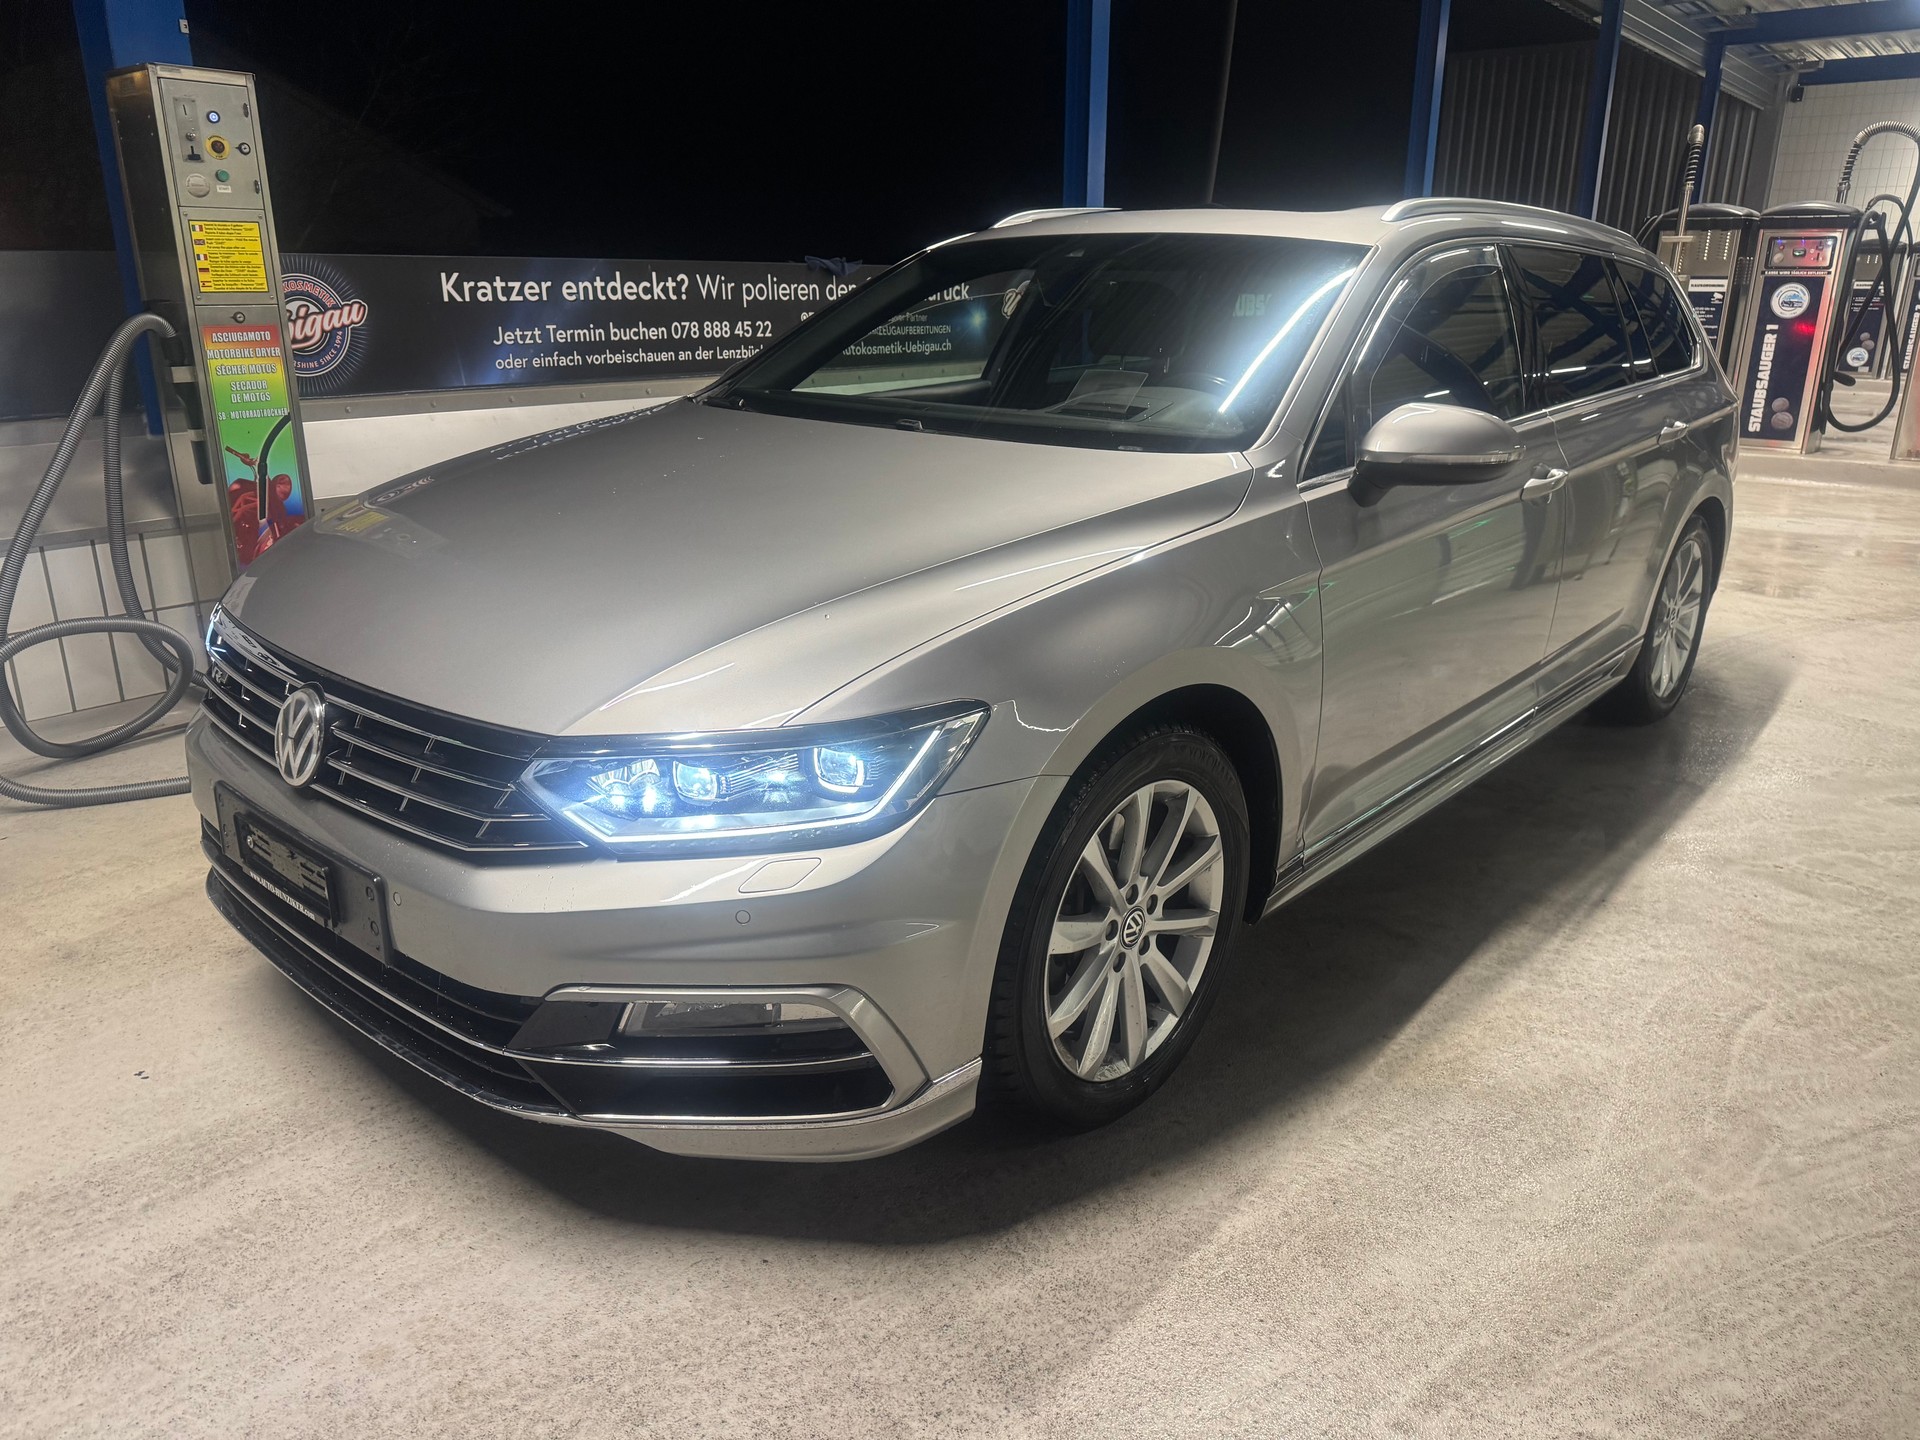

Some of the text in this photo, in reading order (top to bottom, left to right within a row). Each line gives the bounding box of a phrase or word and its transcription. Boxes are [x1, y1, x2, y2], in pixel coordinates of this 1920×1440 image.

[282, 280, 336, 308] KOSMETIK
[440, 272, 552, 302] Kratzer
[561, 272, 689, 301] entdeckt?
[696, 274, 735, 301] Wir
[742, 273, 820, 308] polieren
[212, 331, 271, 343] ASCIUGAMOTO
[493, 320, 773, 346] Jetzt Termin buchen 078 888 45 22
[207, 347, 281, 360] MOTORBIKE DRYER
[843, 338, 952, 356] utokosmetik-Uebigau.ch
[495, 353, 528, 370] oder
[532, 350, 582, 368] einfach
[585, 347, 675, 366] vorbeischauen
[678, 350, 692, 361] an
[695, 346, 714, 360] der
[249, 363, 277, 374] MOTOS
[230, 380, 268, 391] SECADOR
[1748, 333, 1778, 432] STAUBSAUGER
[231, 392, 271, 403] DE MOTOS
